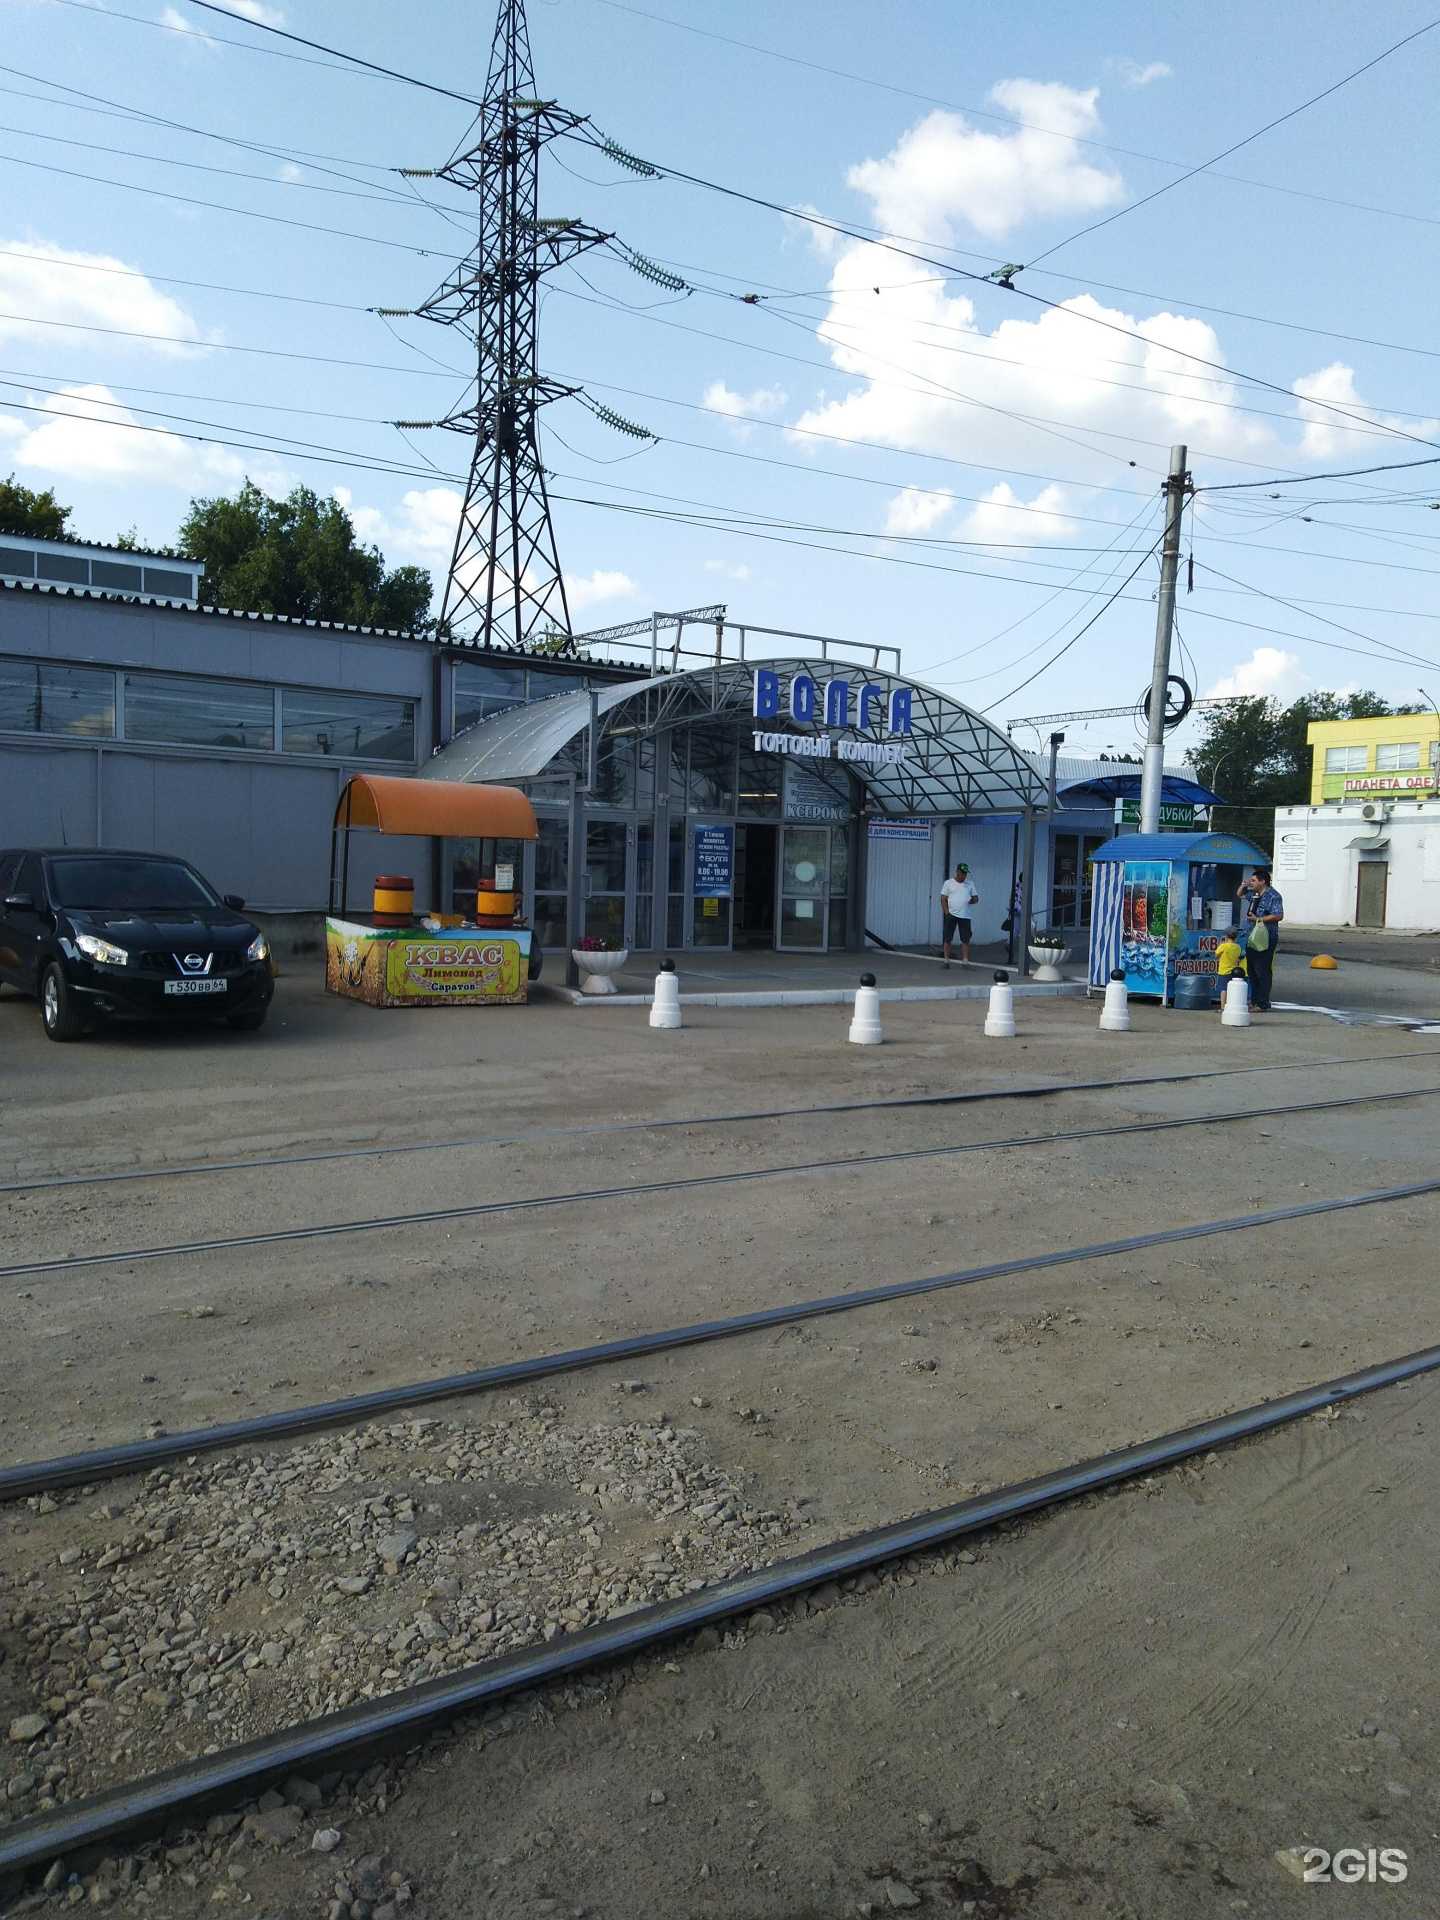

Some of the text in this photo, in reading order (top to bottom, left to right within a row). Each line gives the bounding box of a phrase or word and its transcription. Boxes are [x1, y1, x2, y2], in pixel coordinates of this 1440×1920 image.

[753, 669, 912, 734] ВОЛГА
[752, 730, 909, 764] ТОРГОВЫЙ КОМПЛЕКС
[1345, 776, 1440, 790] ПЛАНЕТА ОДЕ
[405, 944, 504, 967] КВАС
[423, 967, 484, 979] Лимонад
[431, 982, 476, 993] Саратов
